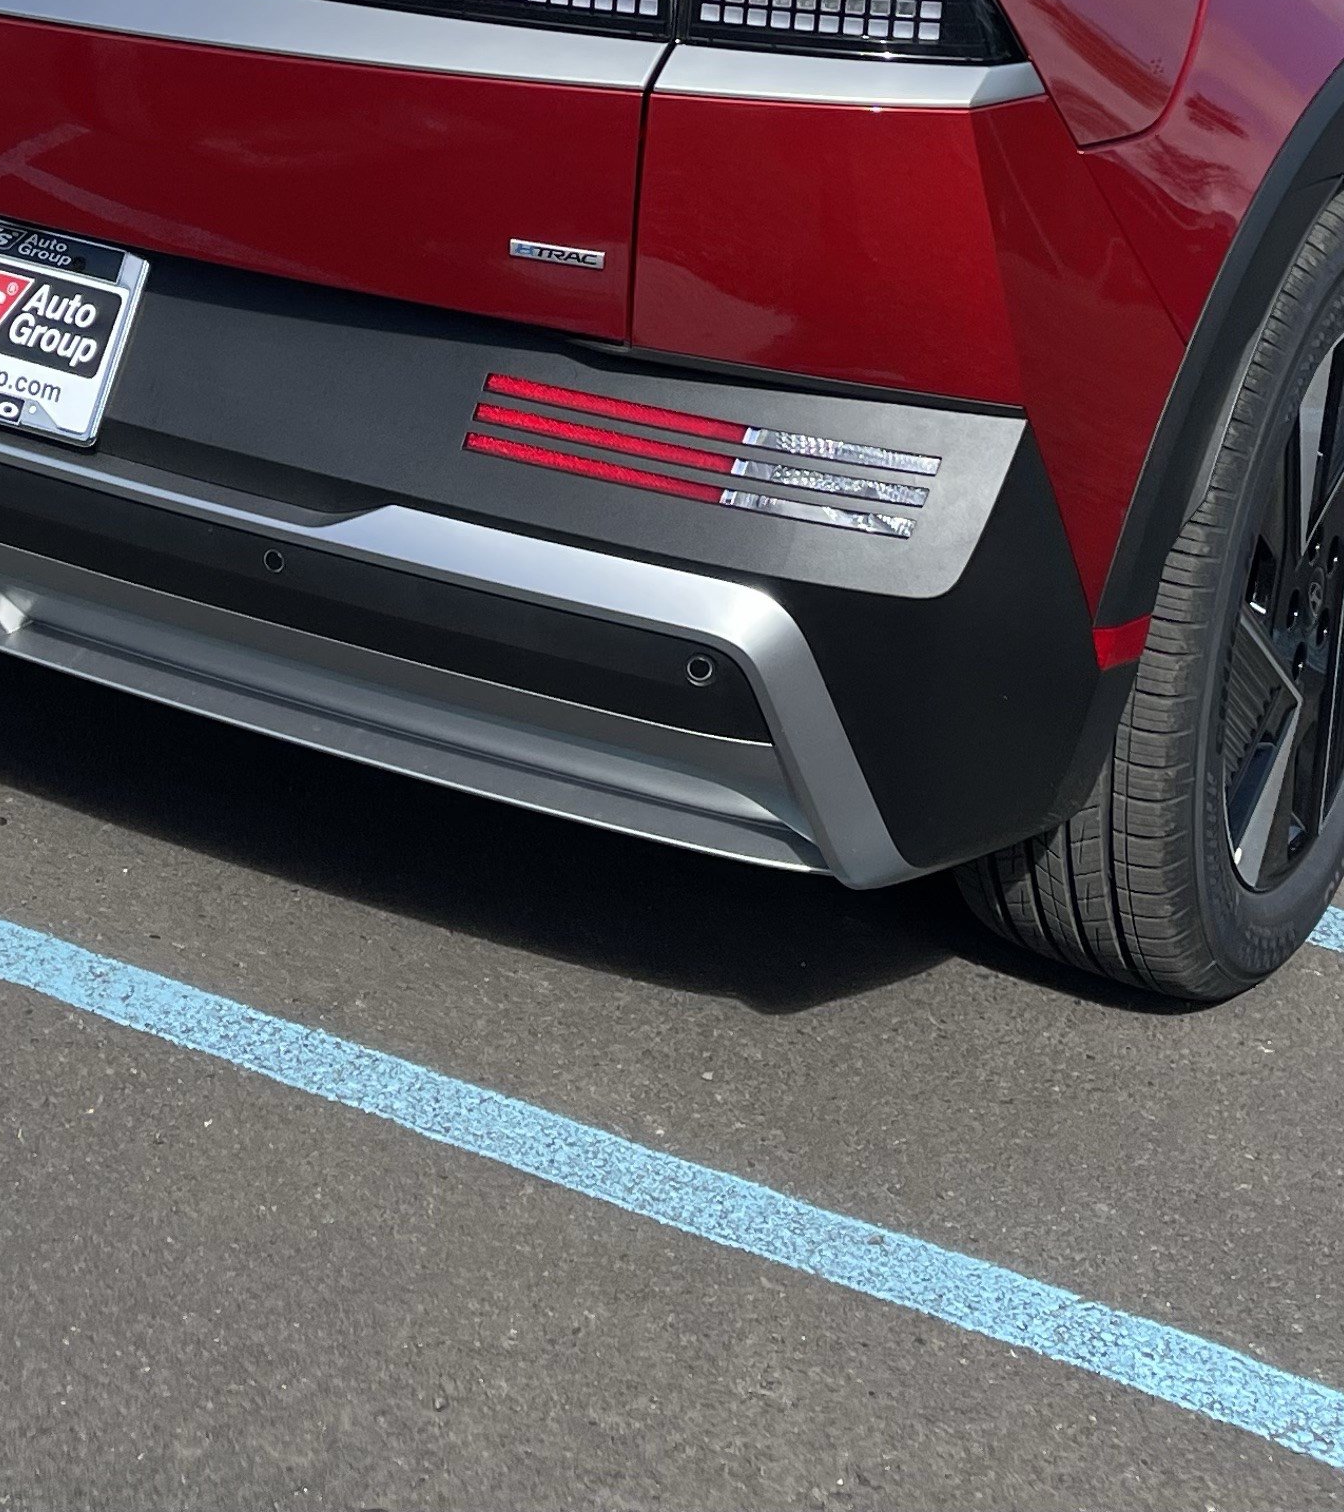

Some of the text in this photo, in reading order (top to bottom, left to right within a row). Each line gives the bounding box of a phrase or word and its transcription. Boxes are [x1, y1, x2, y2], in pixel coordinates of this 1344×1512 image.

[17, 243, 72, 266] Group
[24, 233, 68, 253] Auto
[515, 243, 598, 266] HTRAC
[22, 284, 97, 328] Auto
[9, 312, 98, 367] Group
